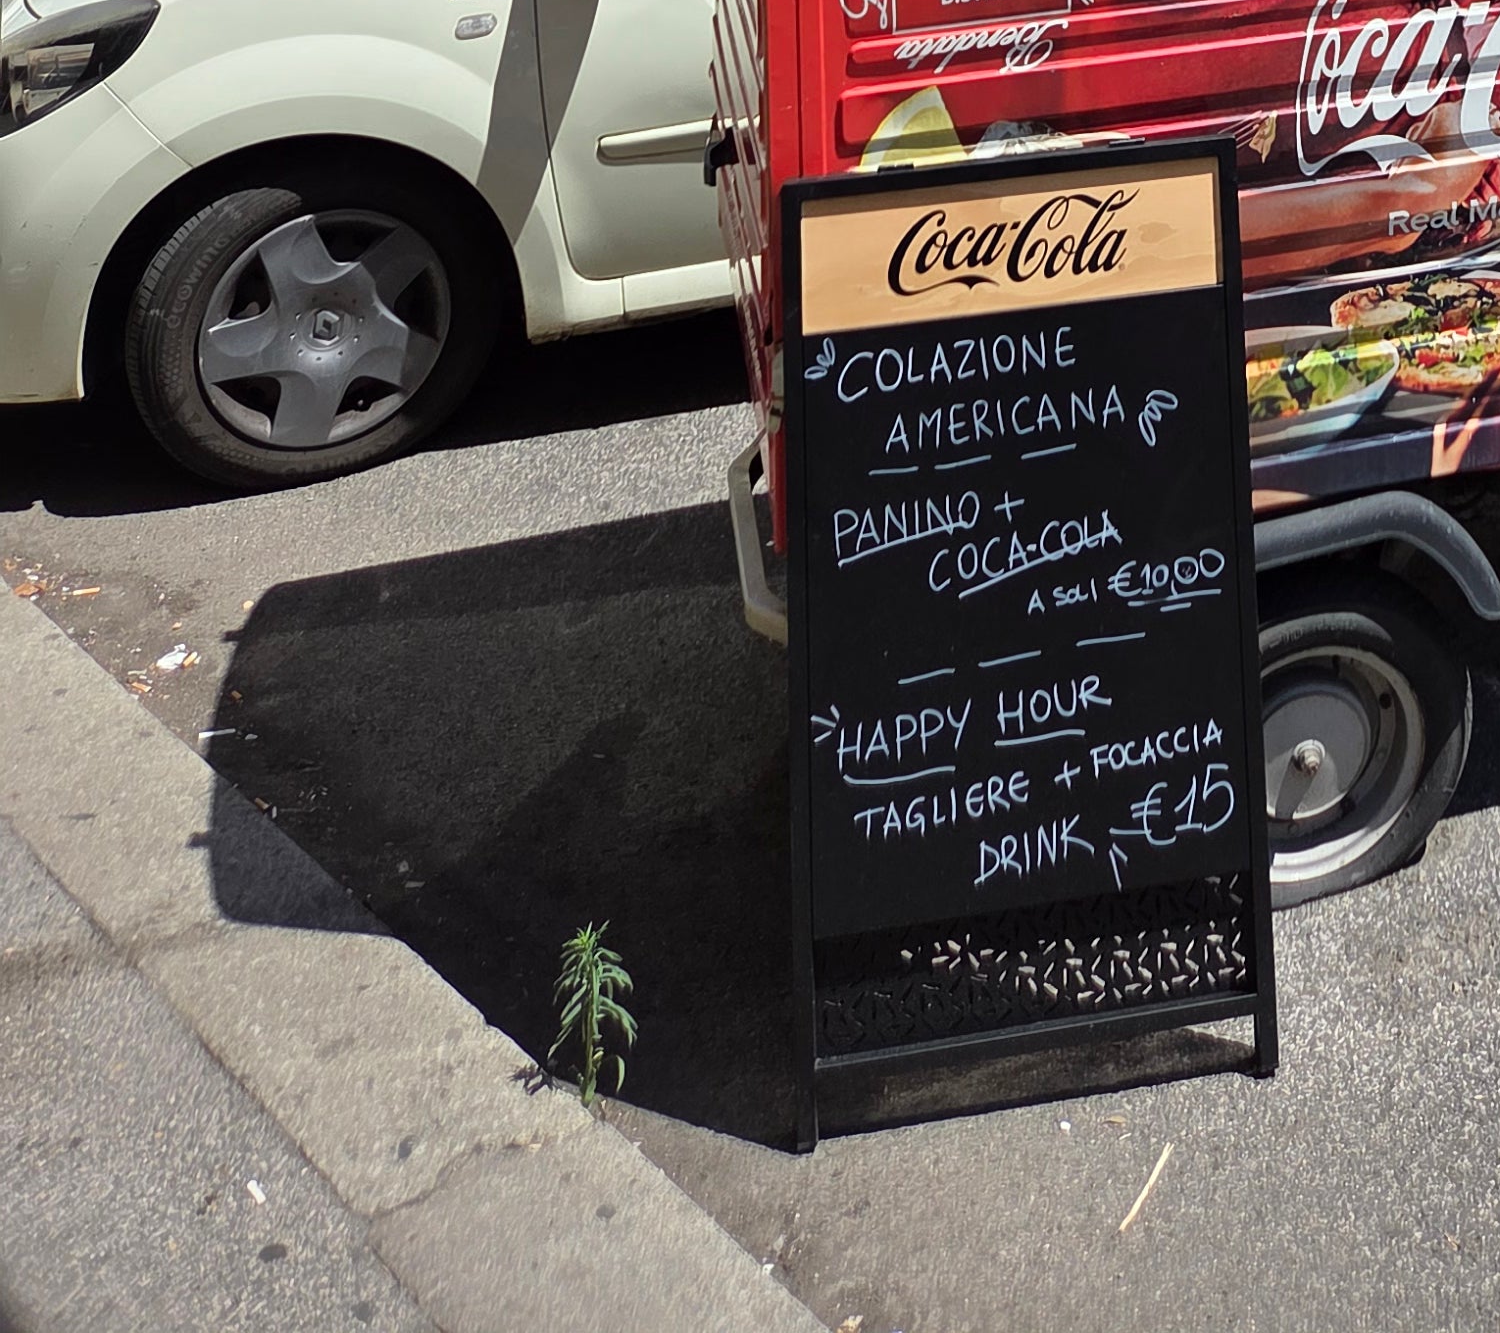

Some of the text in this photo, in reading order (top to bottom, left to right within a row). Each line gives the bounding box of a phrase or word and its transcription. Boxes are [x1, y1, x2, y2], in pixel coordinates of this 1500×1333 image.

[893, 19, 1069, 75] Bendata
[888, 187, 1140, 296] Coca-Cola
[1388, 200, 1460, 237] Real
[837, 326, 1076, 403] COLAZIONE
[885, 385, 1125, 453] AMERICANA
[833, 490, 1025, 559] PANINO +
[929, 510, 1123, 592] COCA-COLA
[1027, 589, 1045, 616] A
[1107, 548, 1226, 598] €10,00
[836, 675, 1112, 770] HAPPY HOUR
[854, 718, 1223, 840] TAGLIERE + FOCACCIA
[974, 763, 1235, 886] DRINK €15
